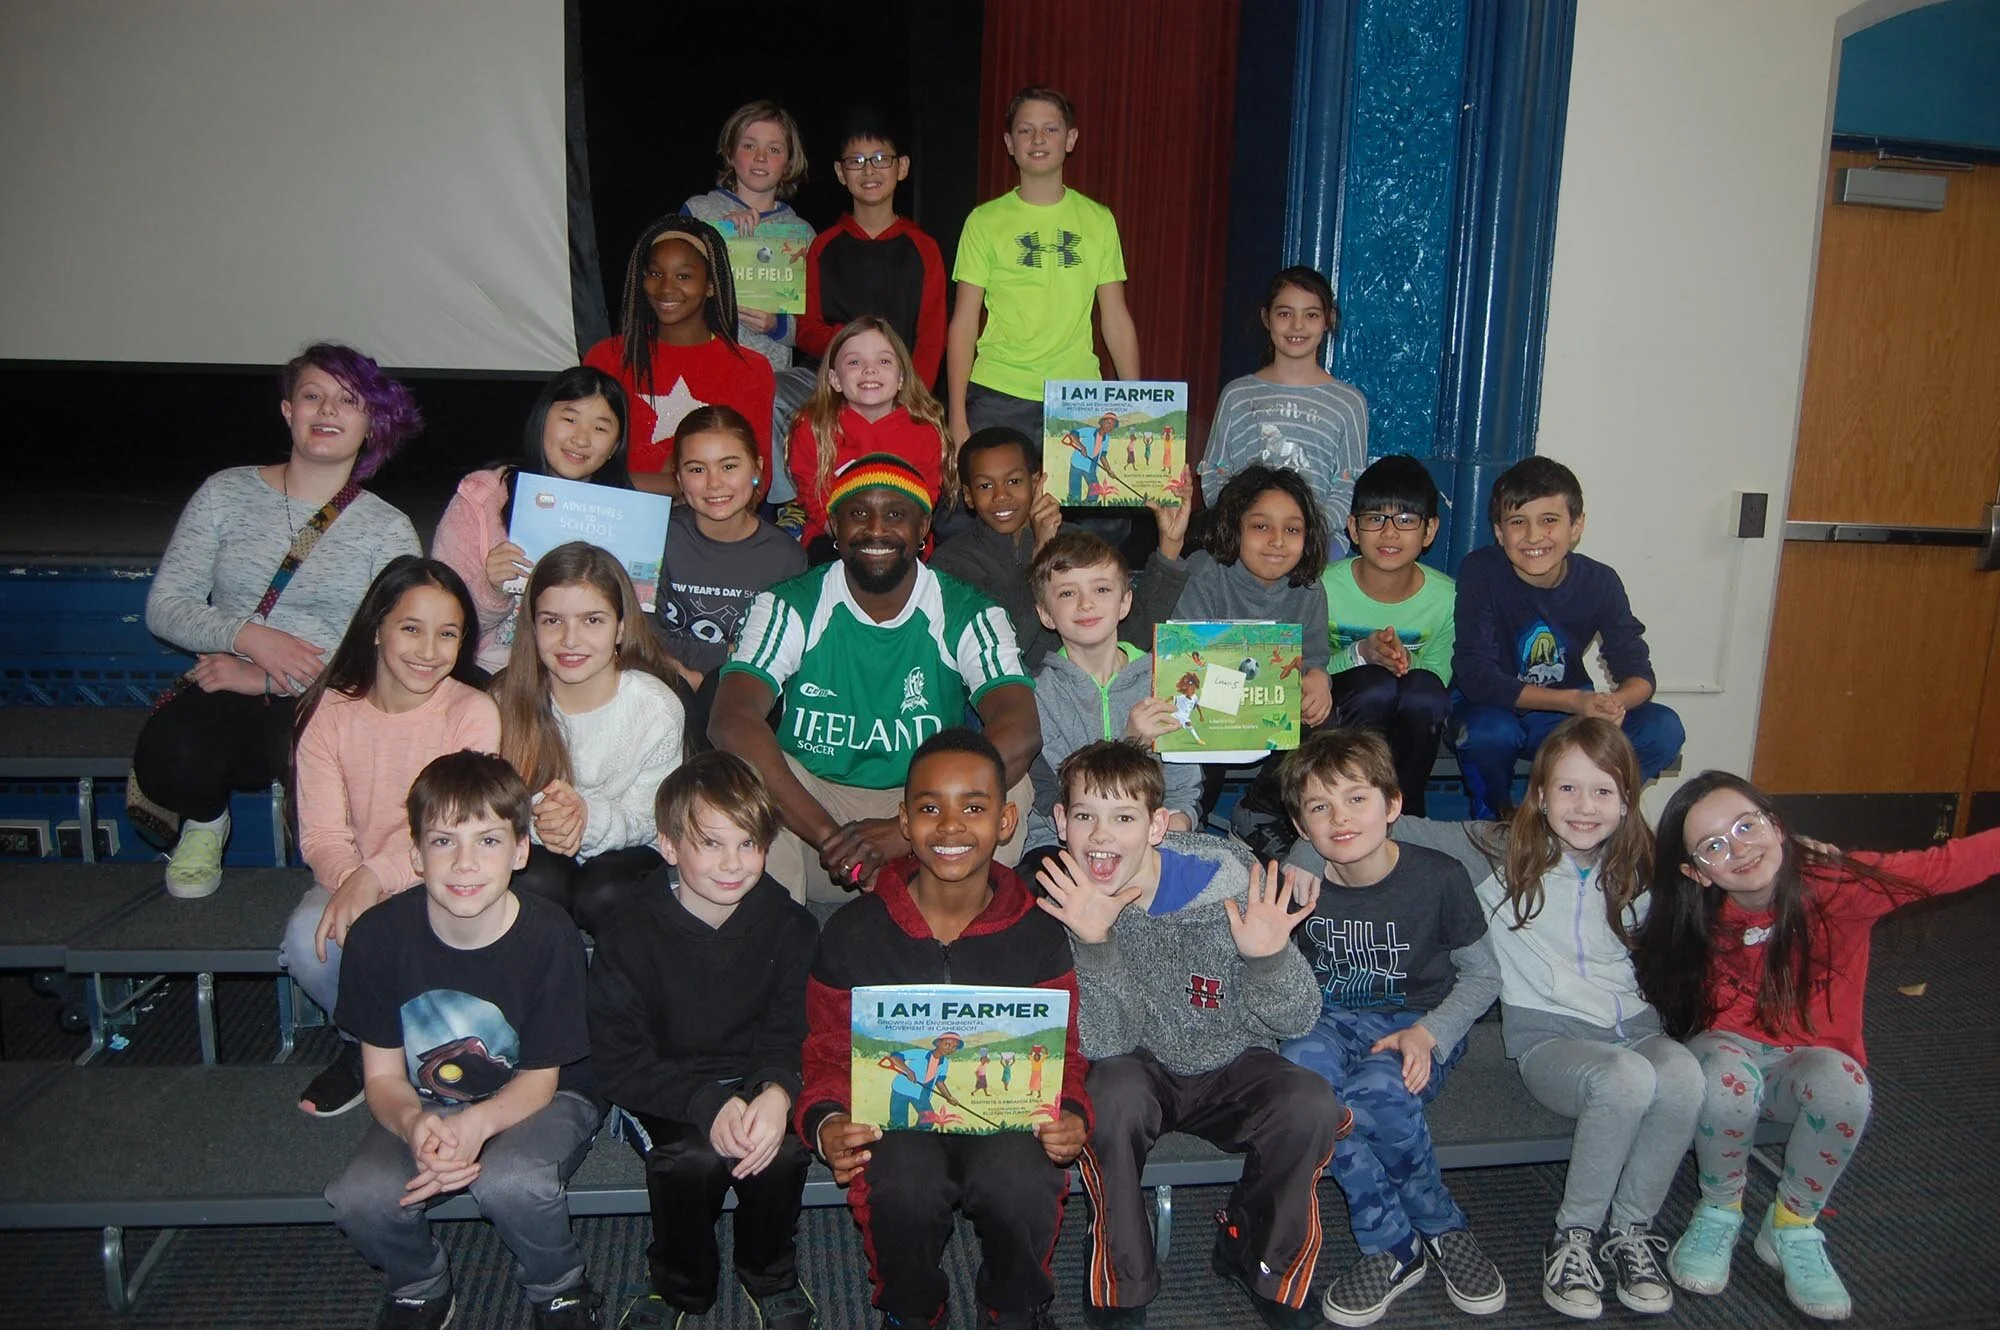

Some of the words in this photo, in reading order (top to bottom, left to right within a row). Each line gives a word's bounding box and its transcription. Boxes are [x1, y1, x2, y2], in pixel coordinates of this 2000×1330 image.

[731, 266, 753, 281] HE
[757, 266, 794, 282] FIELD
[1061, 386, 1067, 400] I
[1070, 387, 1098, 401] AM
[1104, 387, 1175, 403] FARMER
[561, 501, 625, 521] ADVENTURES
[585, 514, 597, 523] TO
[559, 517, 618, 538] SCHOOL
[688, 585, 721, 597] YEAR'S
[722, 588, 743, 598] DAY
[744, 590, 755, 599] 5K
[1240, 685, 1286, 706] FIELD
[793, 706, 943, 753] IRELAND
[796, 739, 835, 757] SOCCER
[1304, 916, 1410, 951] CHILL
[877, 1001, 885, 1018] I
[890, 1002, 931, 1018] AM
[941, 1002, 1049, 1020] FARMER
